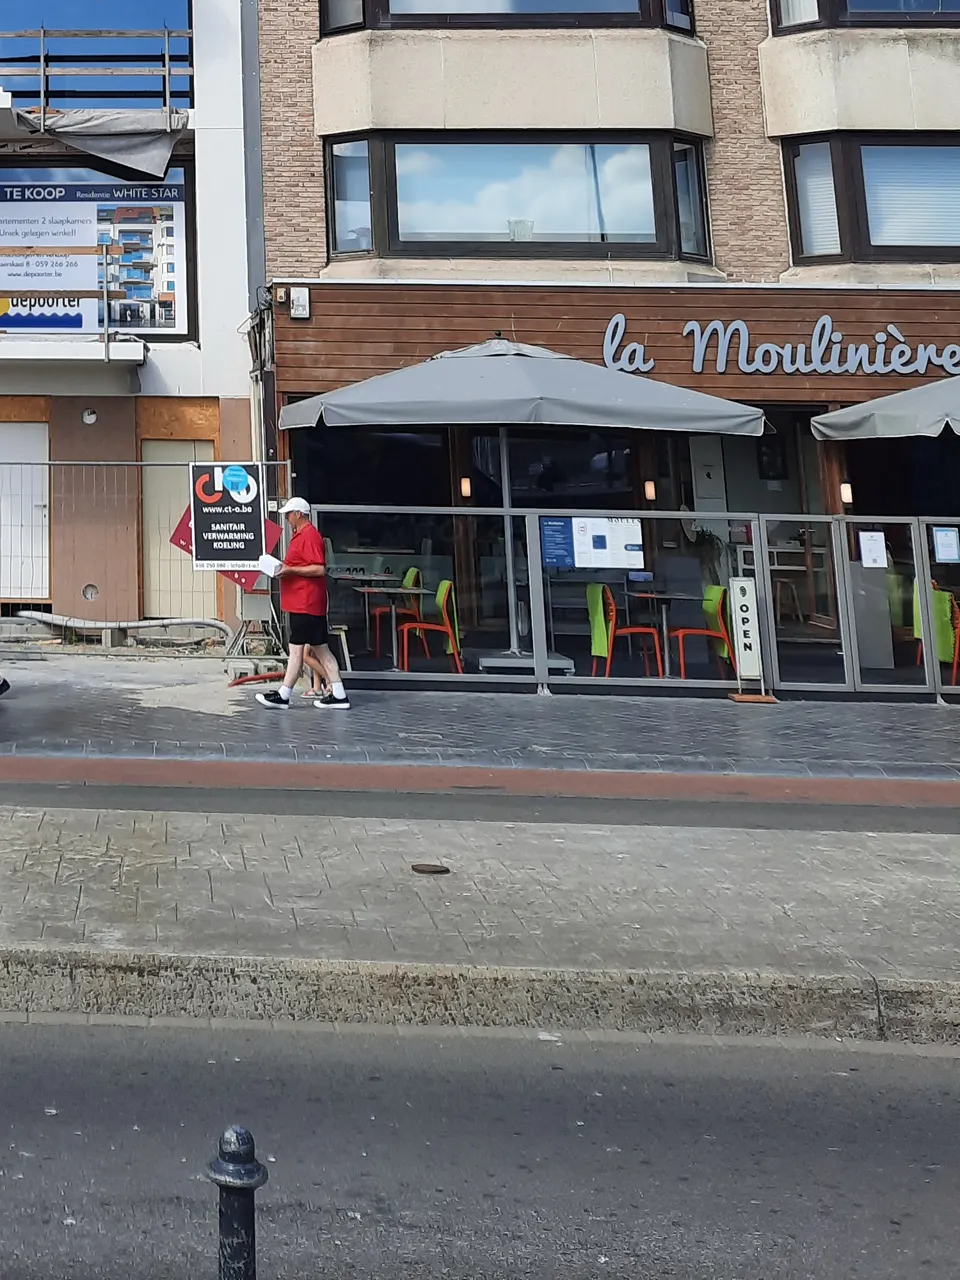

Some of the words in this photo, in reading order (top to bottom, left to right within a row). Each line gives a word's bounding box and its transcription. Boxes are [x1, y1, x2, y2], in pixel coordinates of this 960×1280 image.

[4, 188, 21, 199] TE
[25, 188, 65, 199] KOOP
[113, 188, 148, 198] WHITE
[151, 188, 179, 198] STAR
[48, 217, 92, 226] slaapkamers
[21, 229, 50, 238] gelegen
[11, 297, 80, 311] depoorter
[603, 313, 654, 370] la
[683, 314, 960, 374] Moulinière
[211, 523, 245, 531] SANITAIR
[202, 532, 255, 540] VERWARMING
[213, 541, 245, 549] KOELING
[740, 604, 753, 652] OPEN
